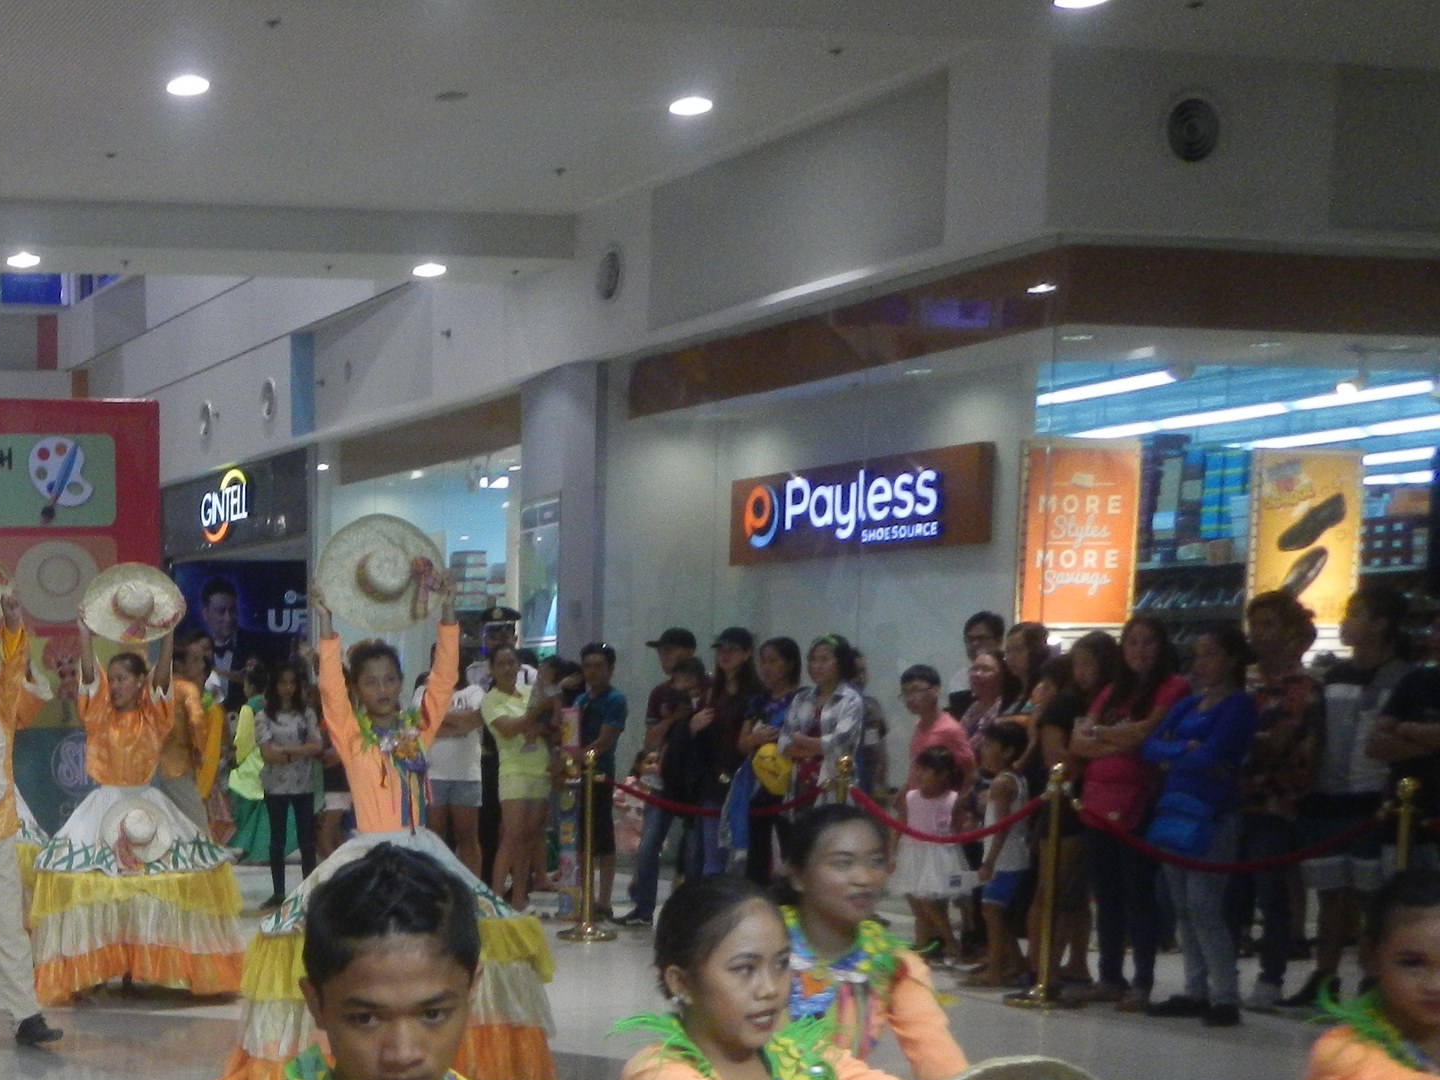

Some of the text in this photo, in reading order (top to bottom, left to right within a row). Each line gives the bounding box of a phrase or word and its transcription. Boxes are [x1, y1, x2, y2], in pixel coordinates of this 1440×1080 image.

[784, 468, 938, 540] Payless
[1038, 494, 1122, 515] MORE
[1051, 514, 1111, 548] Styles
[1035, 549, 1120, 569] MORE
[1039, 569, 1111, 596] Savings
